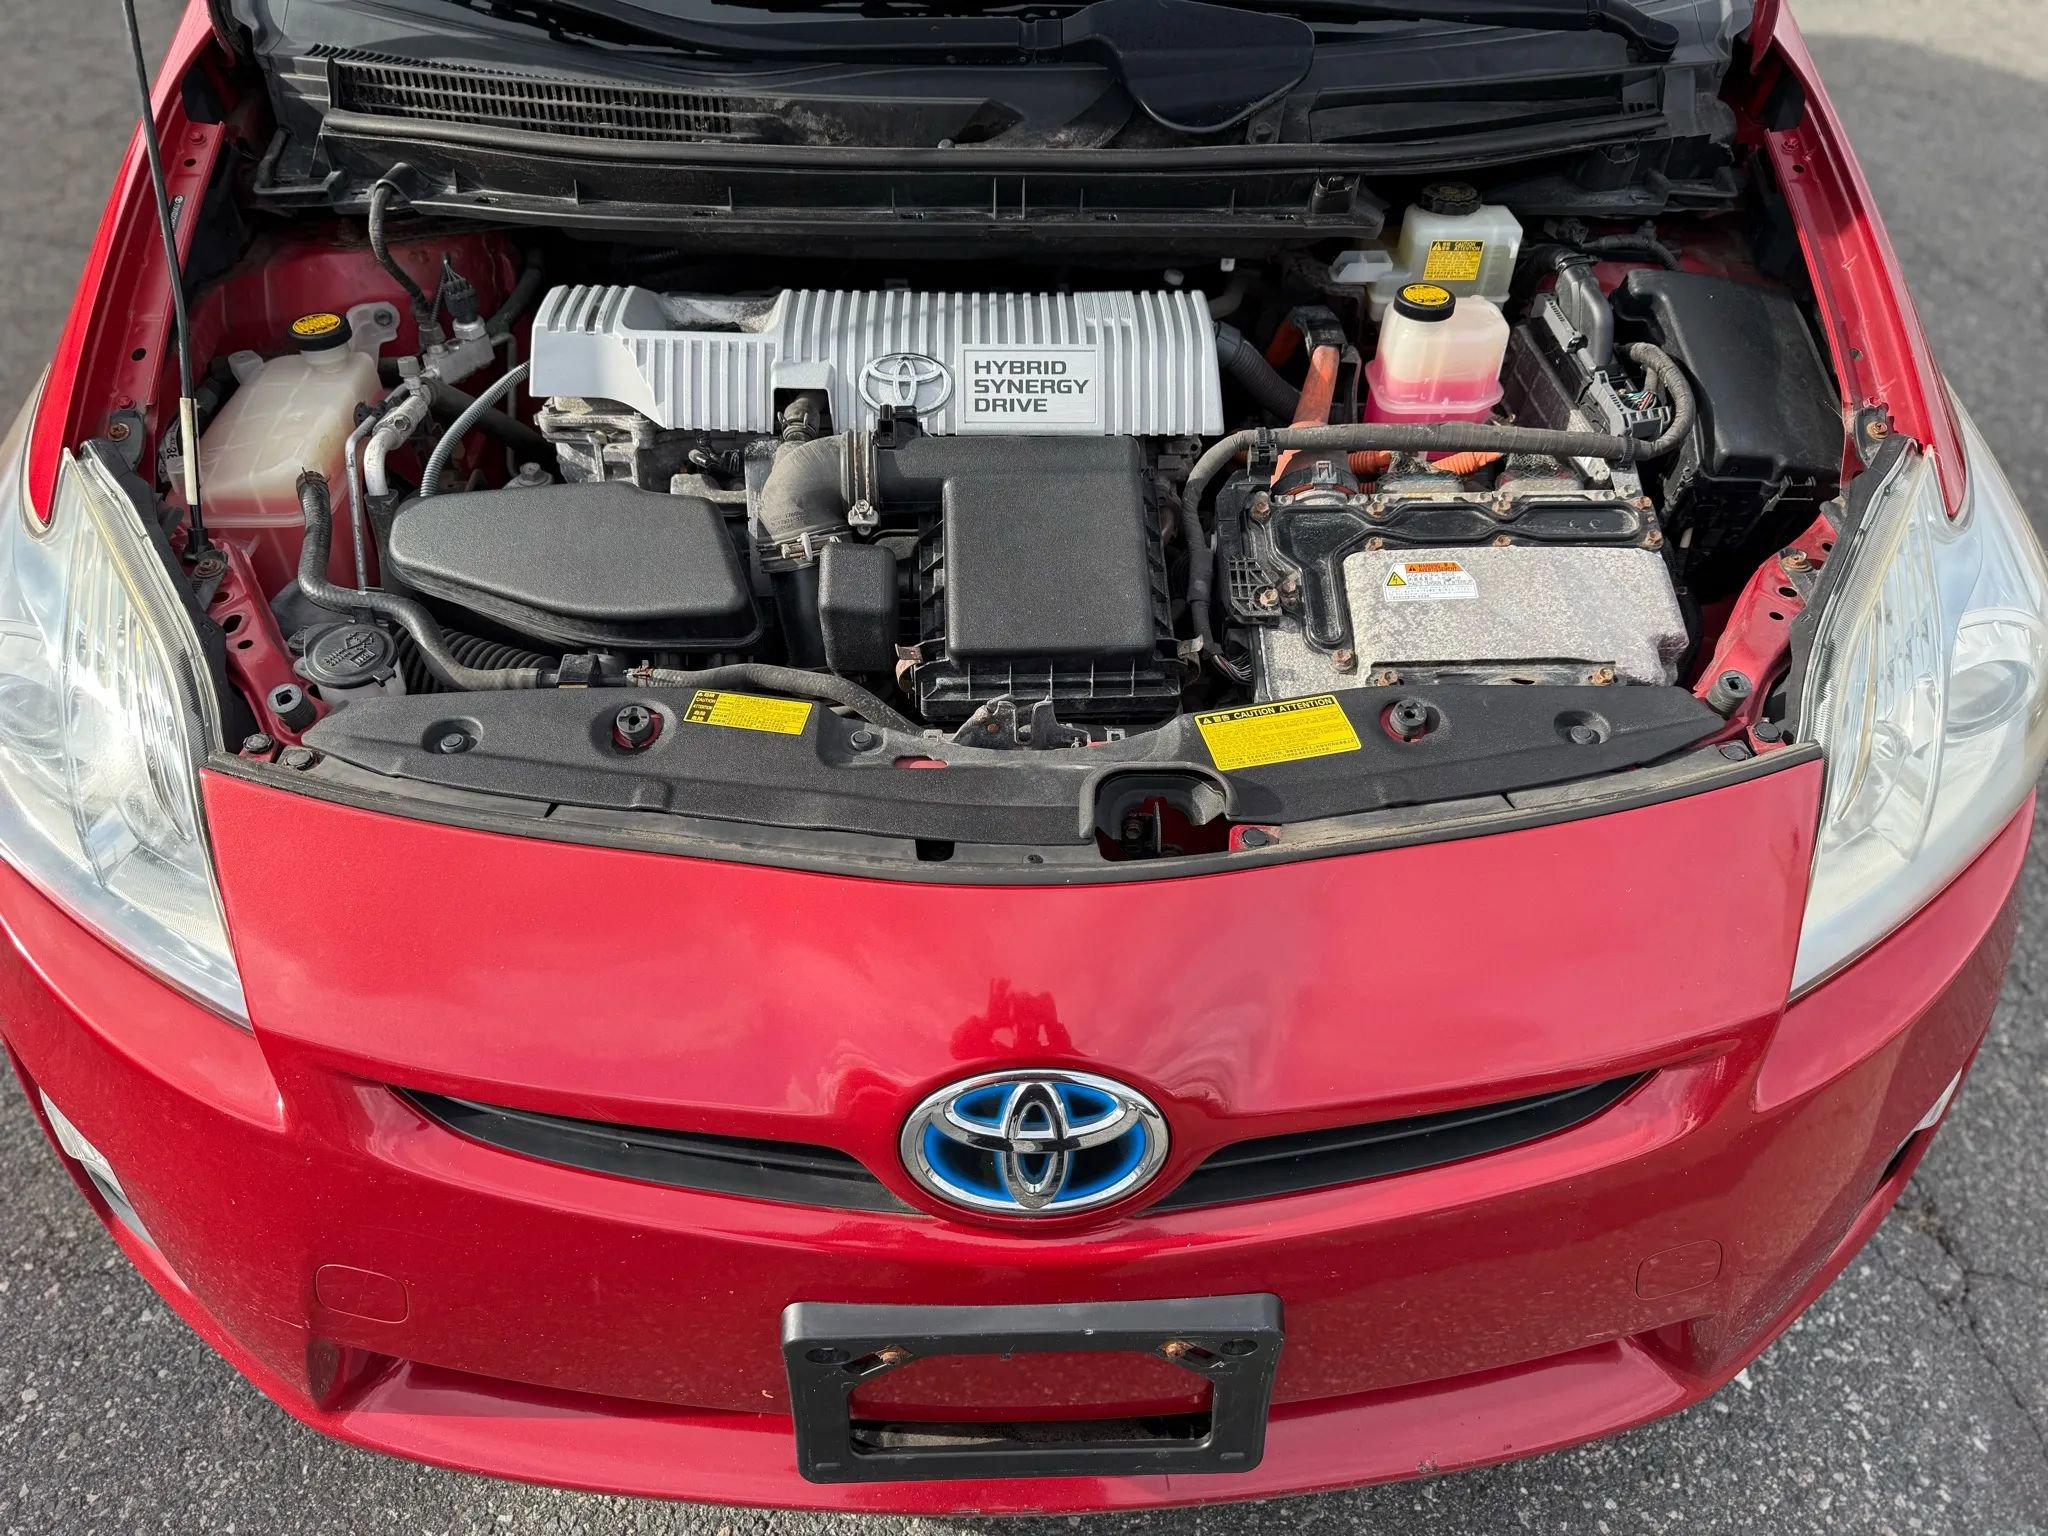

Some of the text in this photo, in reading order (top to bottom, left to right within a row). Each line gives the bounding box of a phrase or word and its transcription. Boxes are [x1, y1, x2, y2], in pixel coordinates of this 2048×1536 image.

[974, 360, 1067, 375] HYBRID
[974, 379, 1089, 394] SYNERGY
[974, 398, 1048, 413] DRIVE
[1233, 707, 1276, 719] CAUTION
[1279, 698, 1333, 713] ATTENTION
